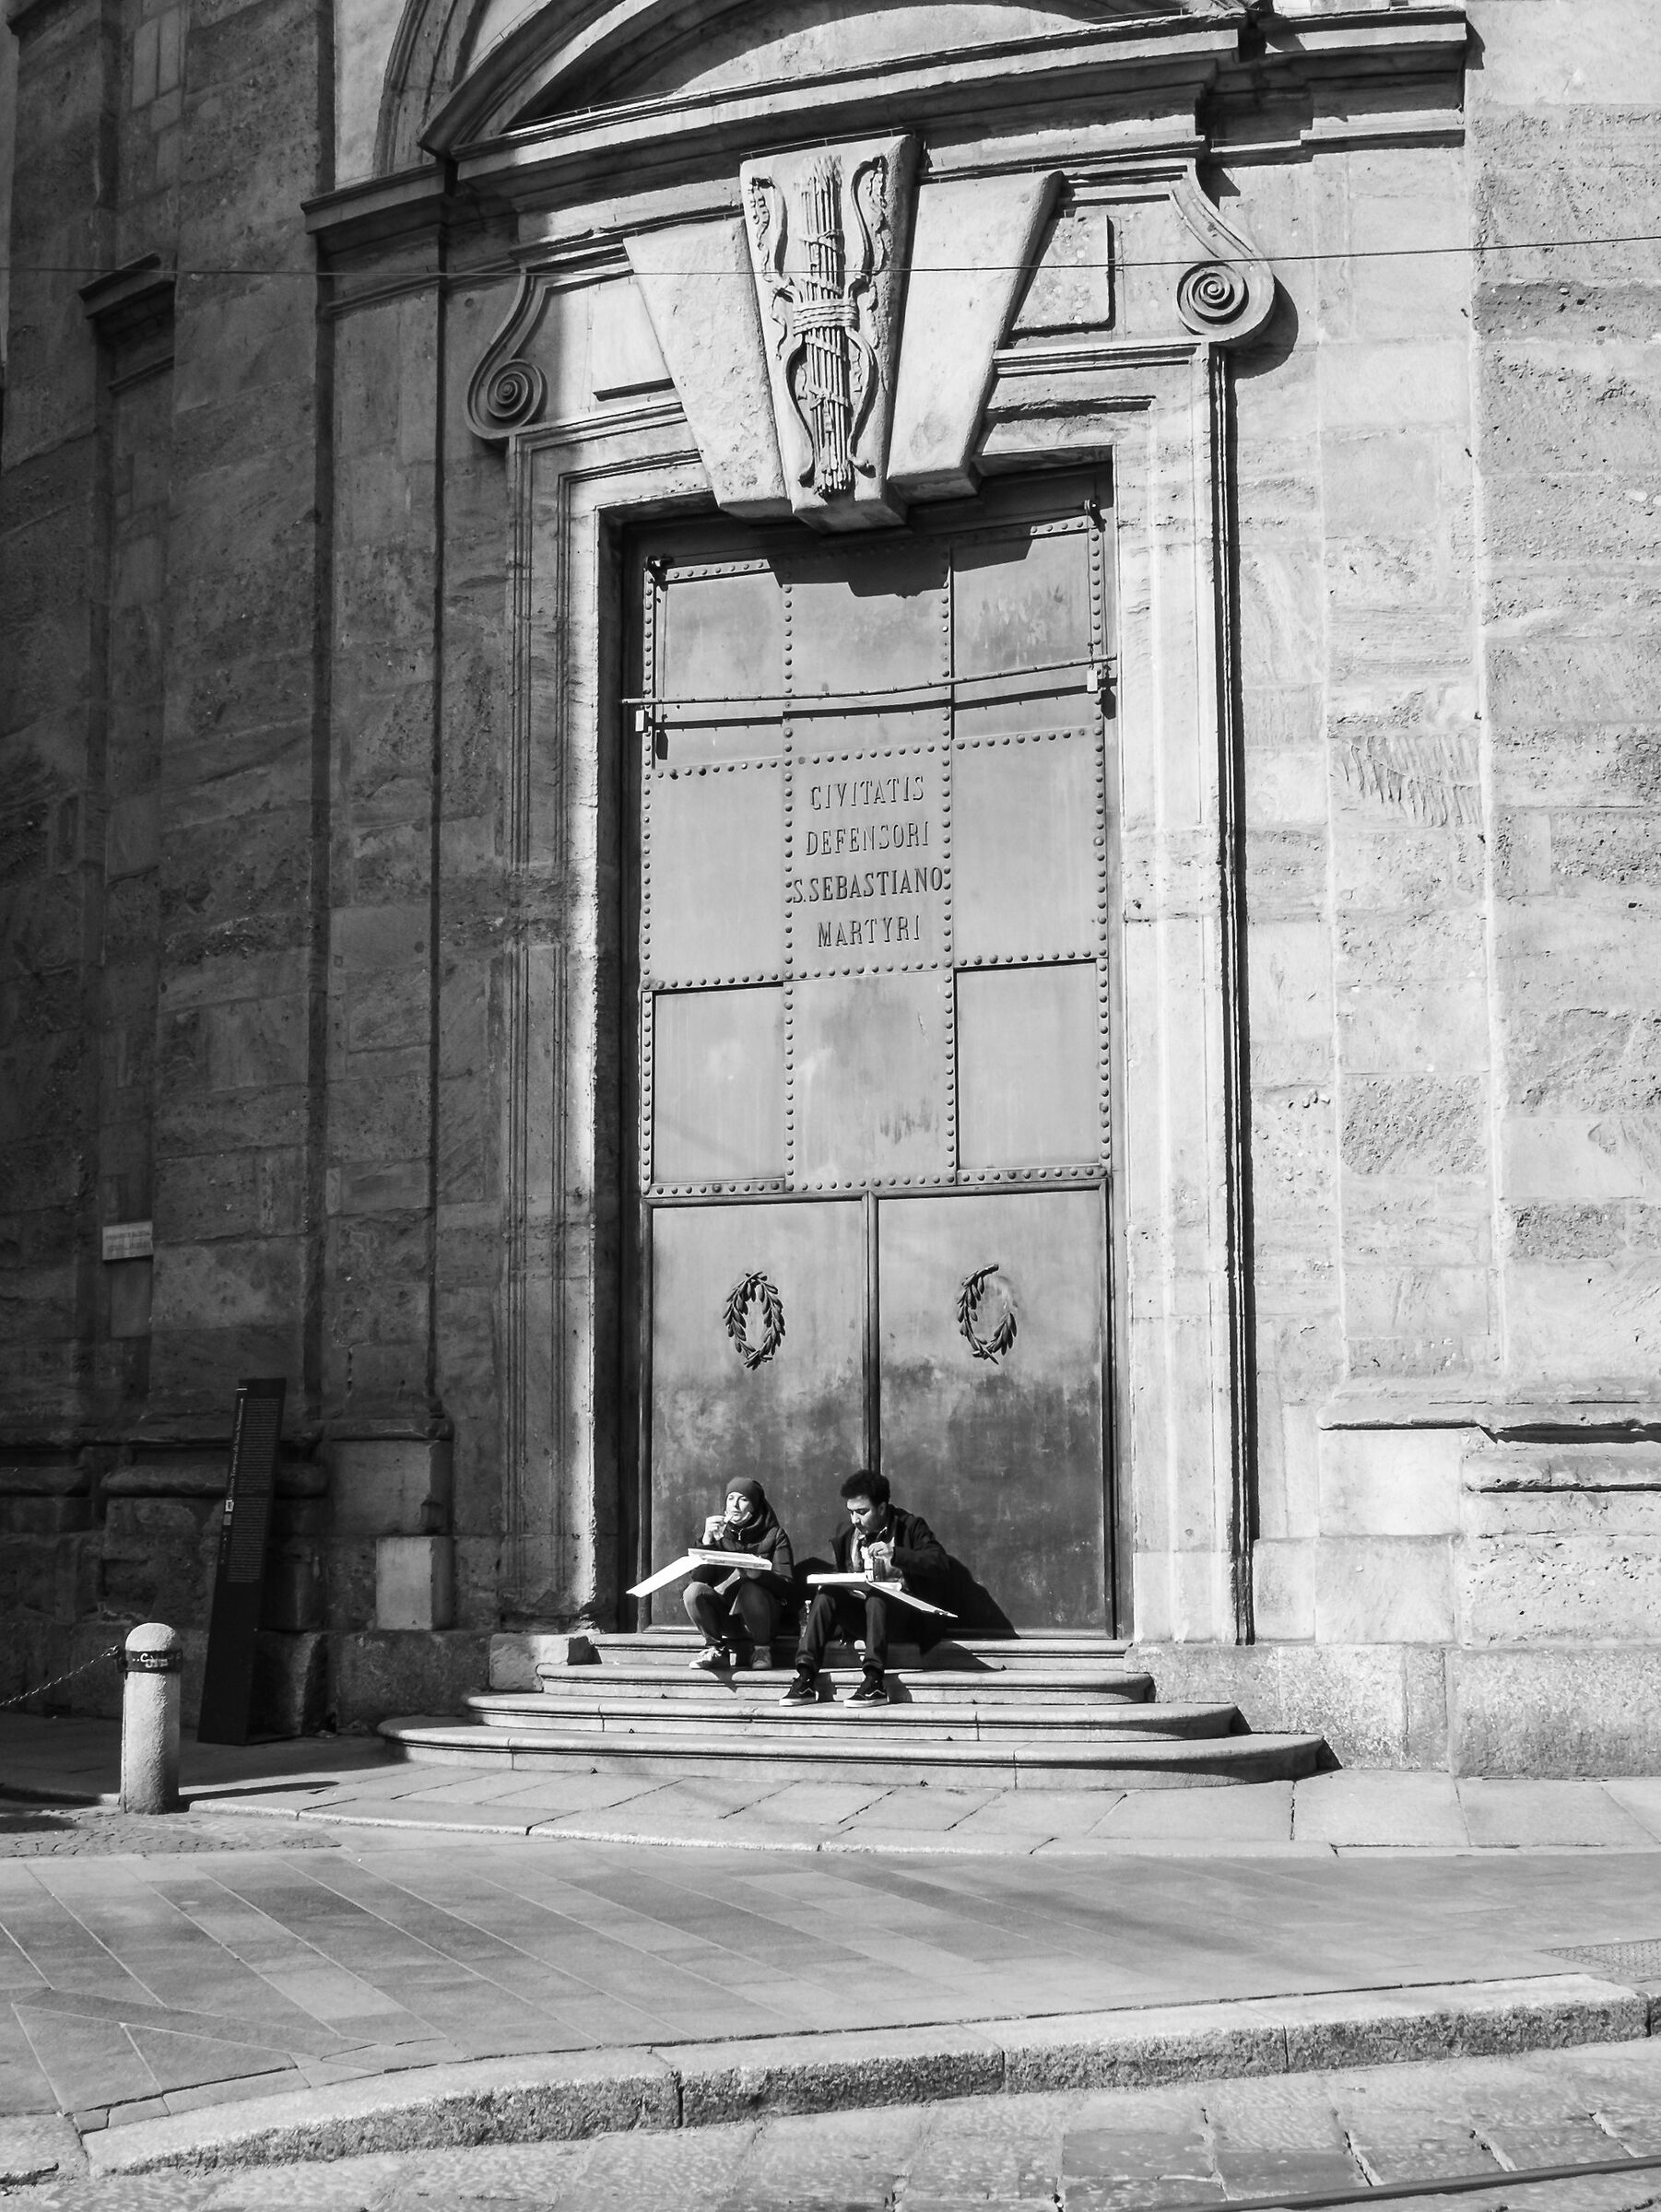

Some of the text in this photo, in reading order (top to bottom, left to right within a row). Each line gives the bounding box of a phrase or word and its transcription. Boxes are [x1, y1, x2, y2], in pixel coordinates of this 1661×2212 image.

[810, 776, 924, 810] CIVITATIS
[806, 820, 928, 855] DEFENSORI
[818, 914, 920, 947] MARTYRI
